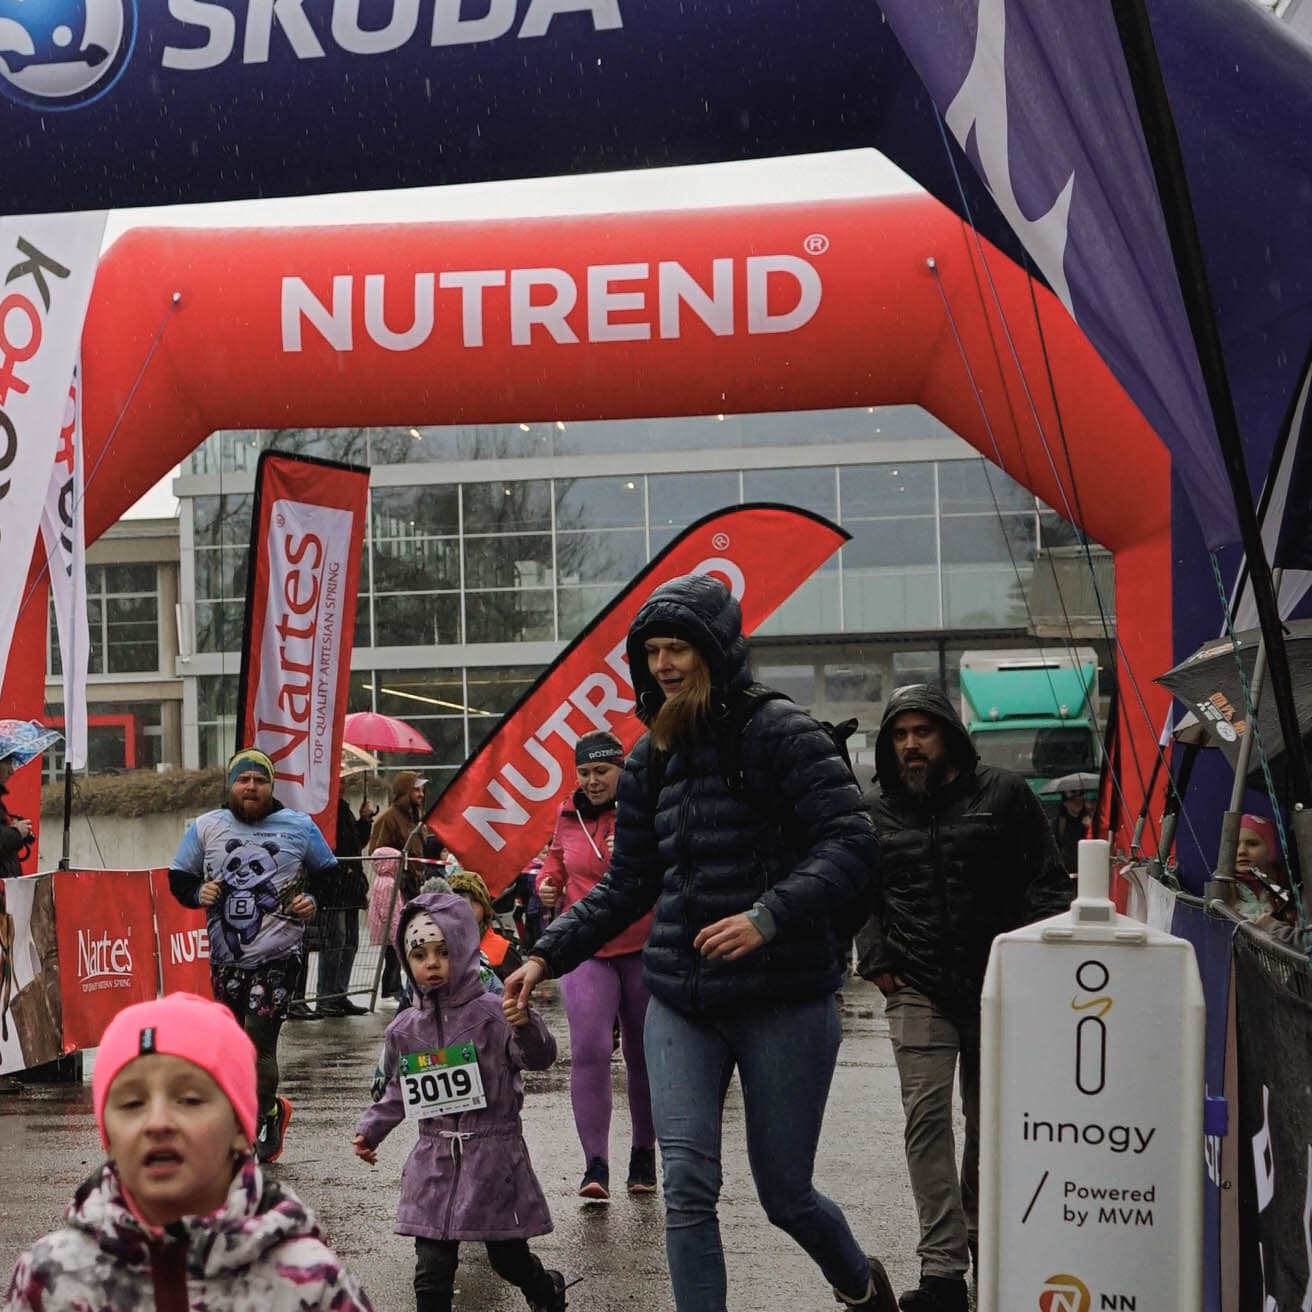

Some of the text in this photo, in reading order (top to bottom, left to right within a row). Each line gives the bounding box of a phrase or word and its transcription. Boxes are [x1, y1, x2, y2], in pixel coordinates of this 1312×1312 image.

[280, 253, 823, 353] NUTREND
[258, 533, 324, 788] Nartes
[313, 562, 341, 766] TOP QUALITY ARTESIAN SPRING
[78, 928, 133, 977] Nartes
[405, 1068, 472, 1105] 3019
[1023, 1112, 1156, 1154] innogy
[1064, 1181, 1155, 1203] Powered
[1063, 1204, 1154, 1227] by MVM
[1100, 1293, 1137, 1312] NN
